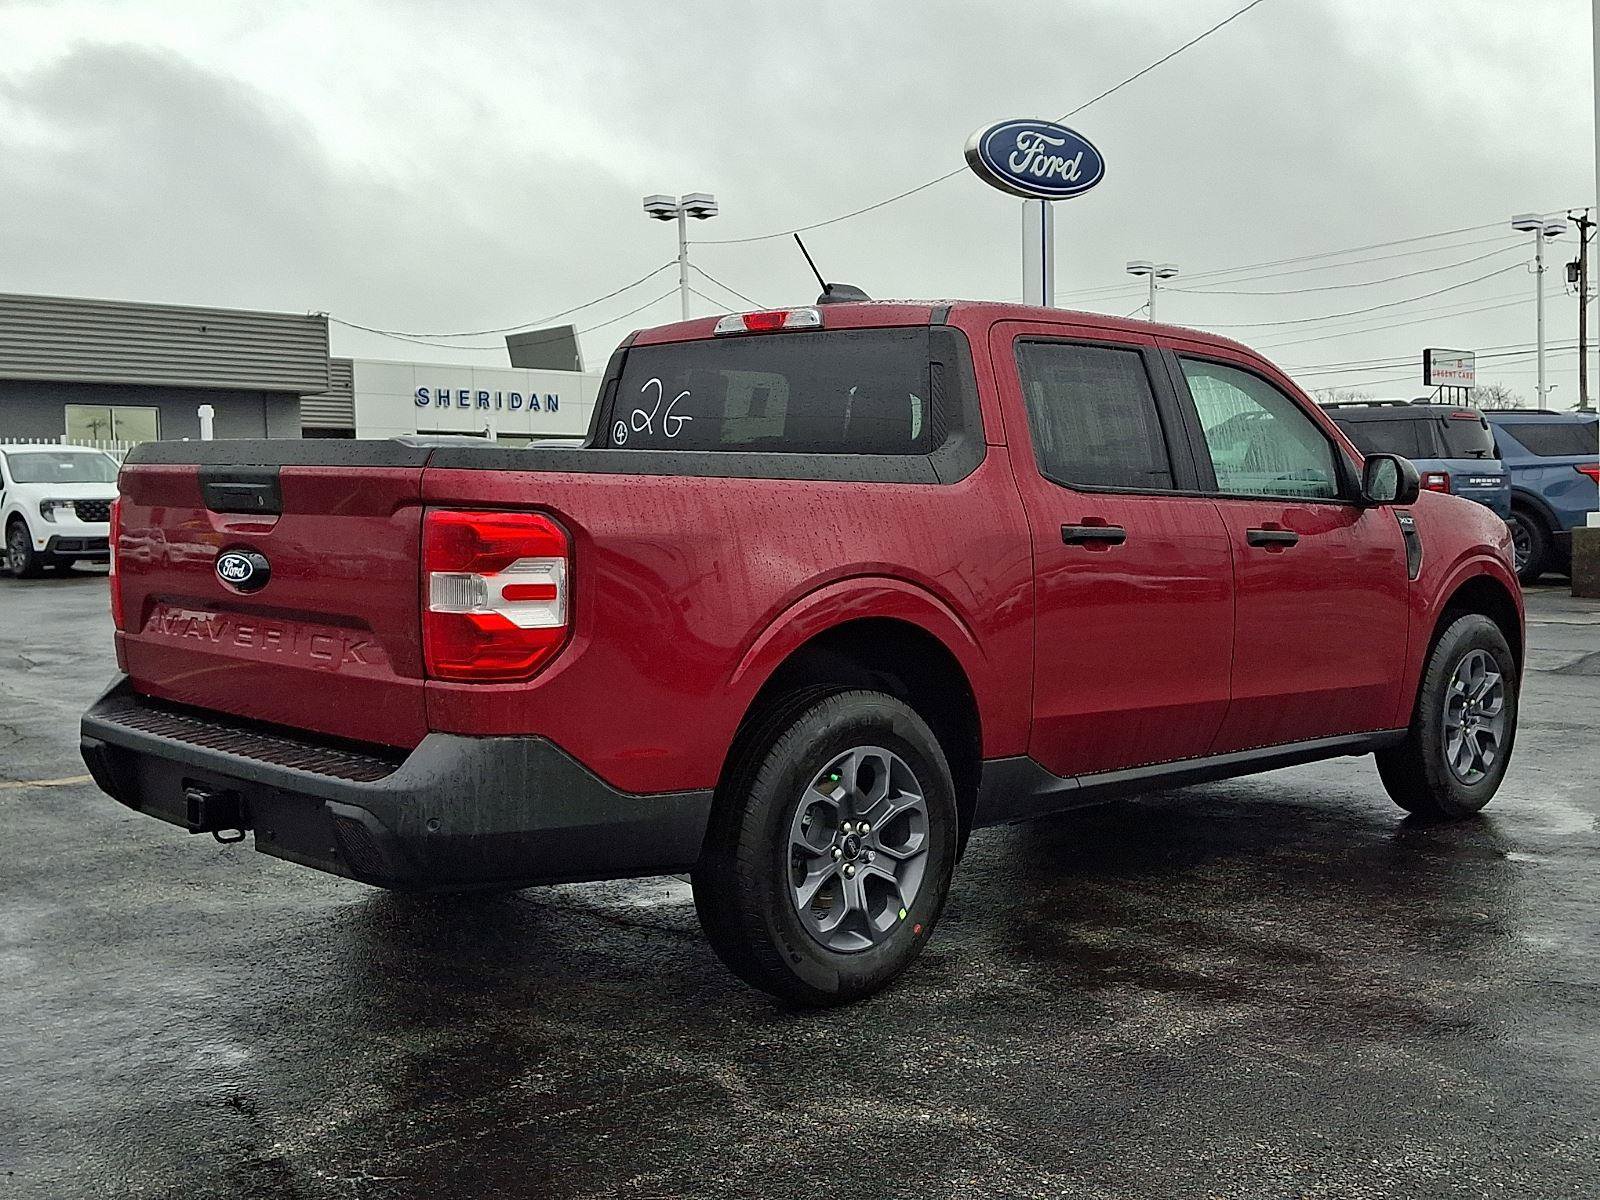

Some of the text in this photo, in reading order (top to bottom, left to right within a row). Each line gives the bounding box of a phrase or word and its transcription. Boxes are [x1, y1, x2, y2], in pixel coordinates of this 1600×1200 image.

[1008, 131, 1083, 182] Ford
[414, 387, 560, 412] SHERIDAN
[222, 557, 245, 577] Ford
[151, 609, 372, 664] MAVERICK
